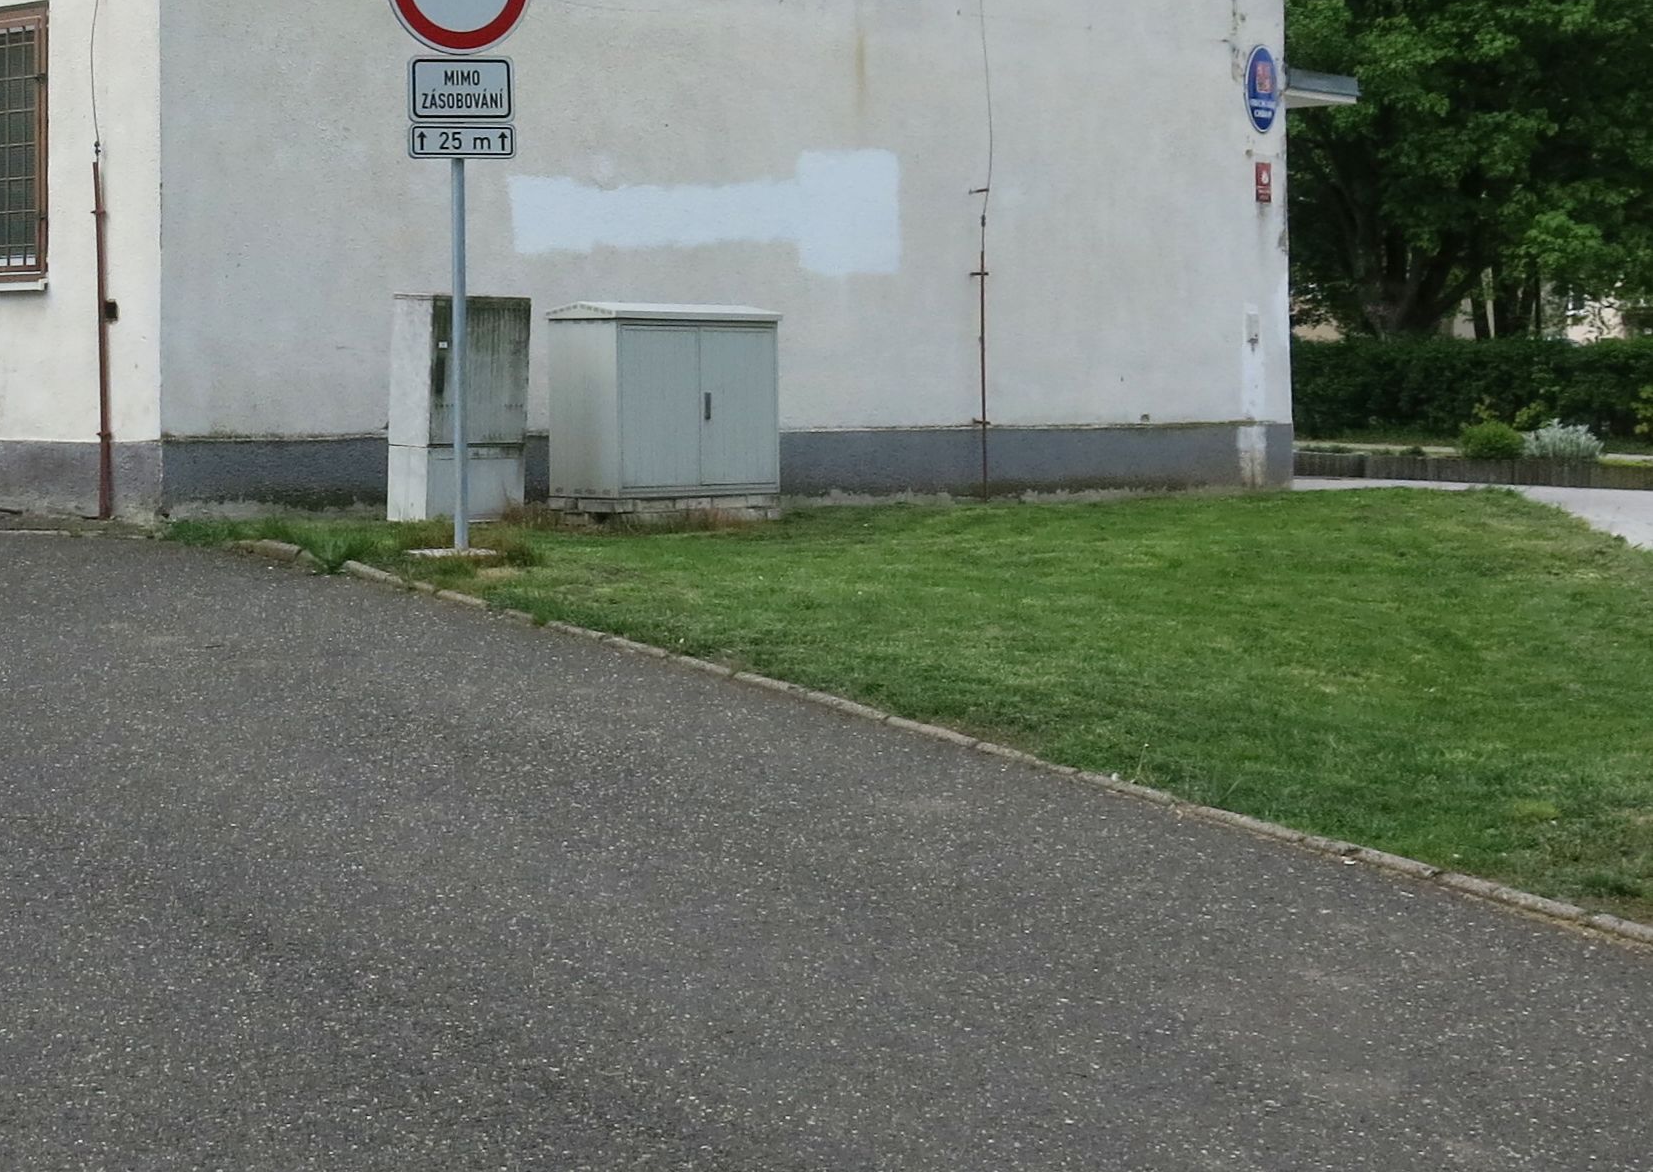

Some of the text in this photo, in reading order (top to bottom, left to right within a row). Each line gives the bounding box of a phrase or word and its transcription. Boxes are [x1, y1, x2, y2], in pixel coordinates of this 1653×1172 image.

[444, 70, 480, 86] MIMO
[421, 88, 503, 109] ZÁSOBOVÁNÍ
[439, 131, 491, 150] 25 m
